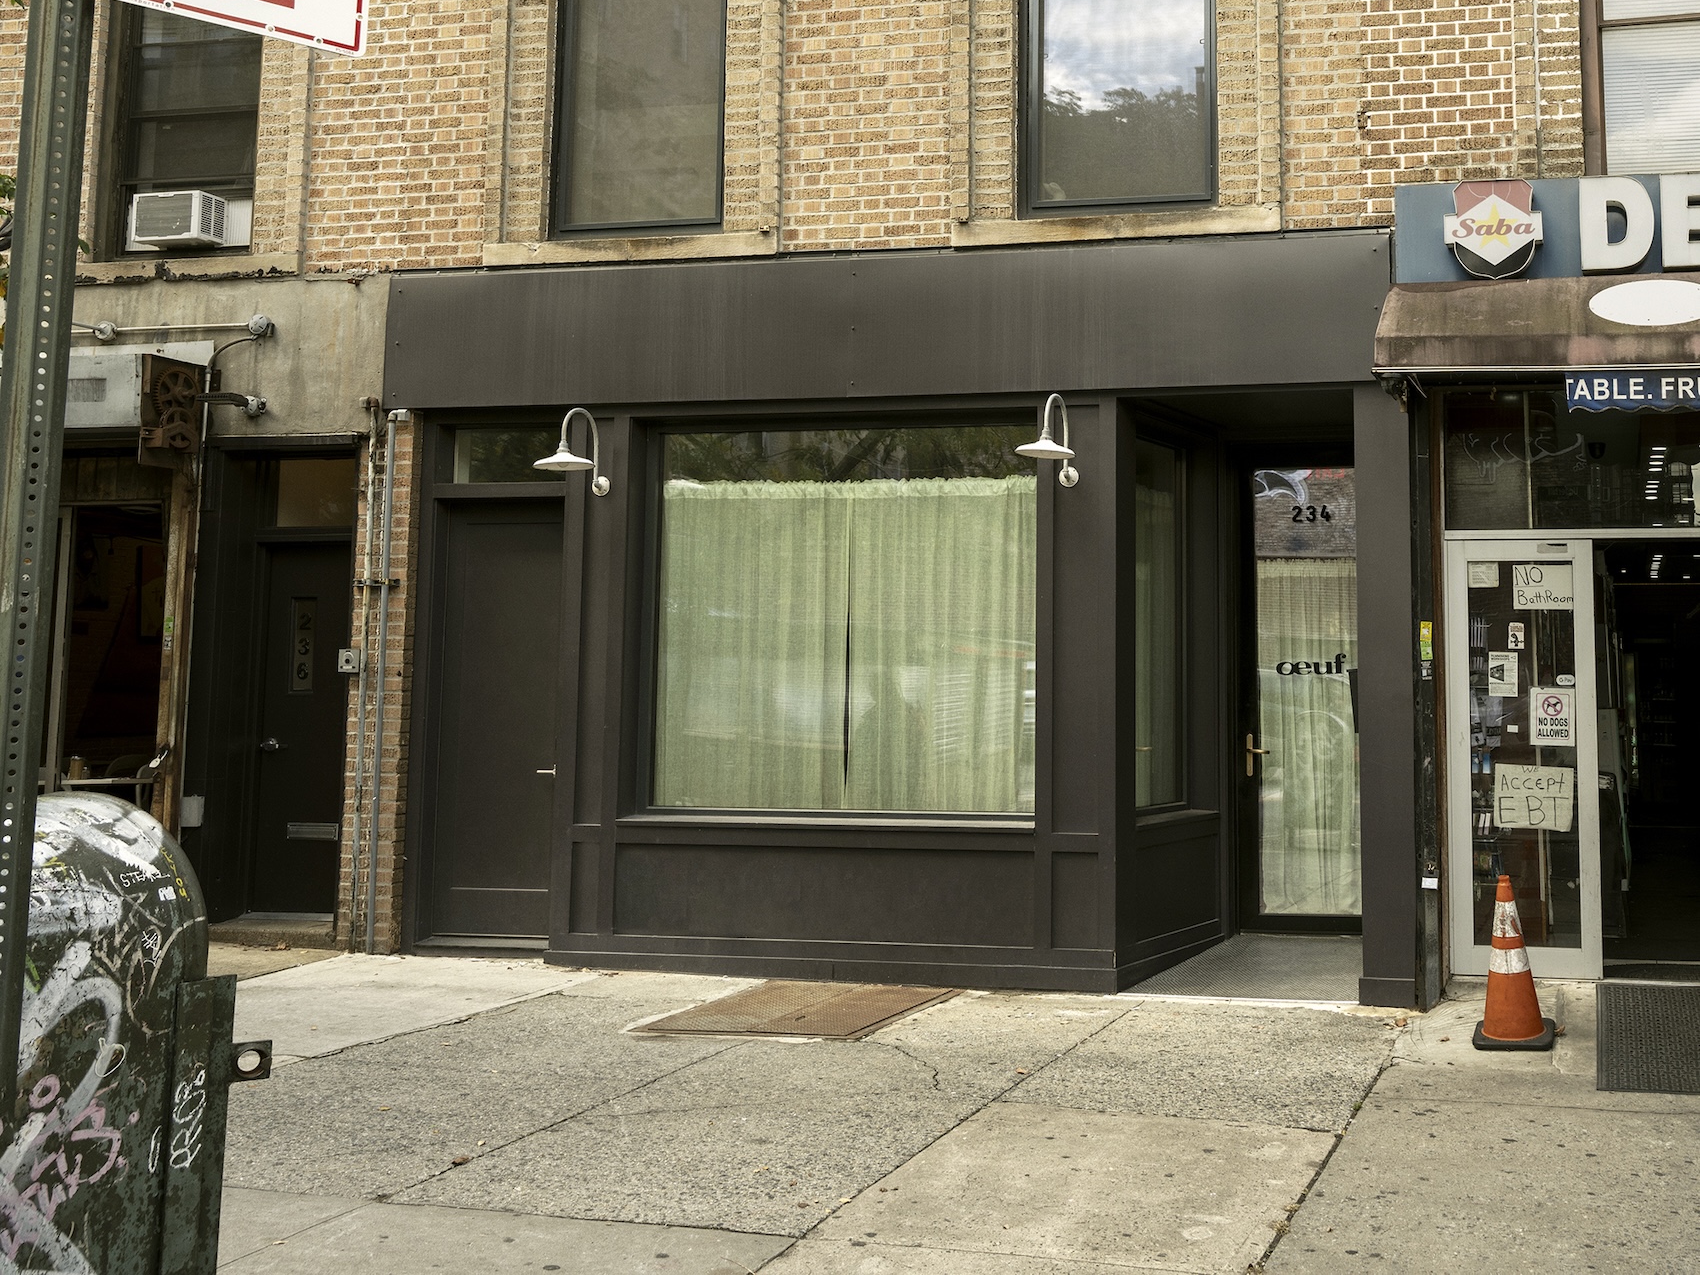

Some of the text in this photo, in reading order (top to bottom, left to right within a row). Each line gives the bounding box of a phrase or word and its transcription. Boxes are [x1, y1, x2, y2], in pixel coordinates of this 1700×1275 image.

[1451, 218, 1536, 239] Saba
[1660, 376, 1700, 400] FR
[1291, 505, 1331, 523] 234
[1514, 566, 1543, 586] NO
[296, 612, 312, 680] 236
[1538, 717, 1569, 727] NO DOGS
[1537, 728, 1569, 738] ALLOWED
[1498, 795, 1569, 827] EBT
